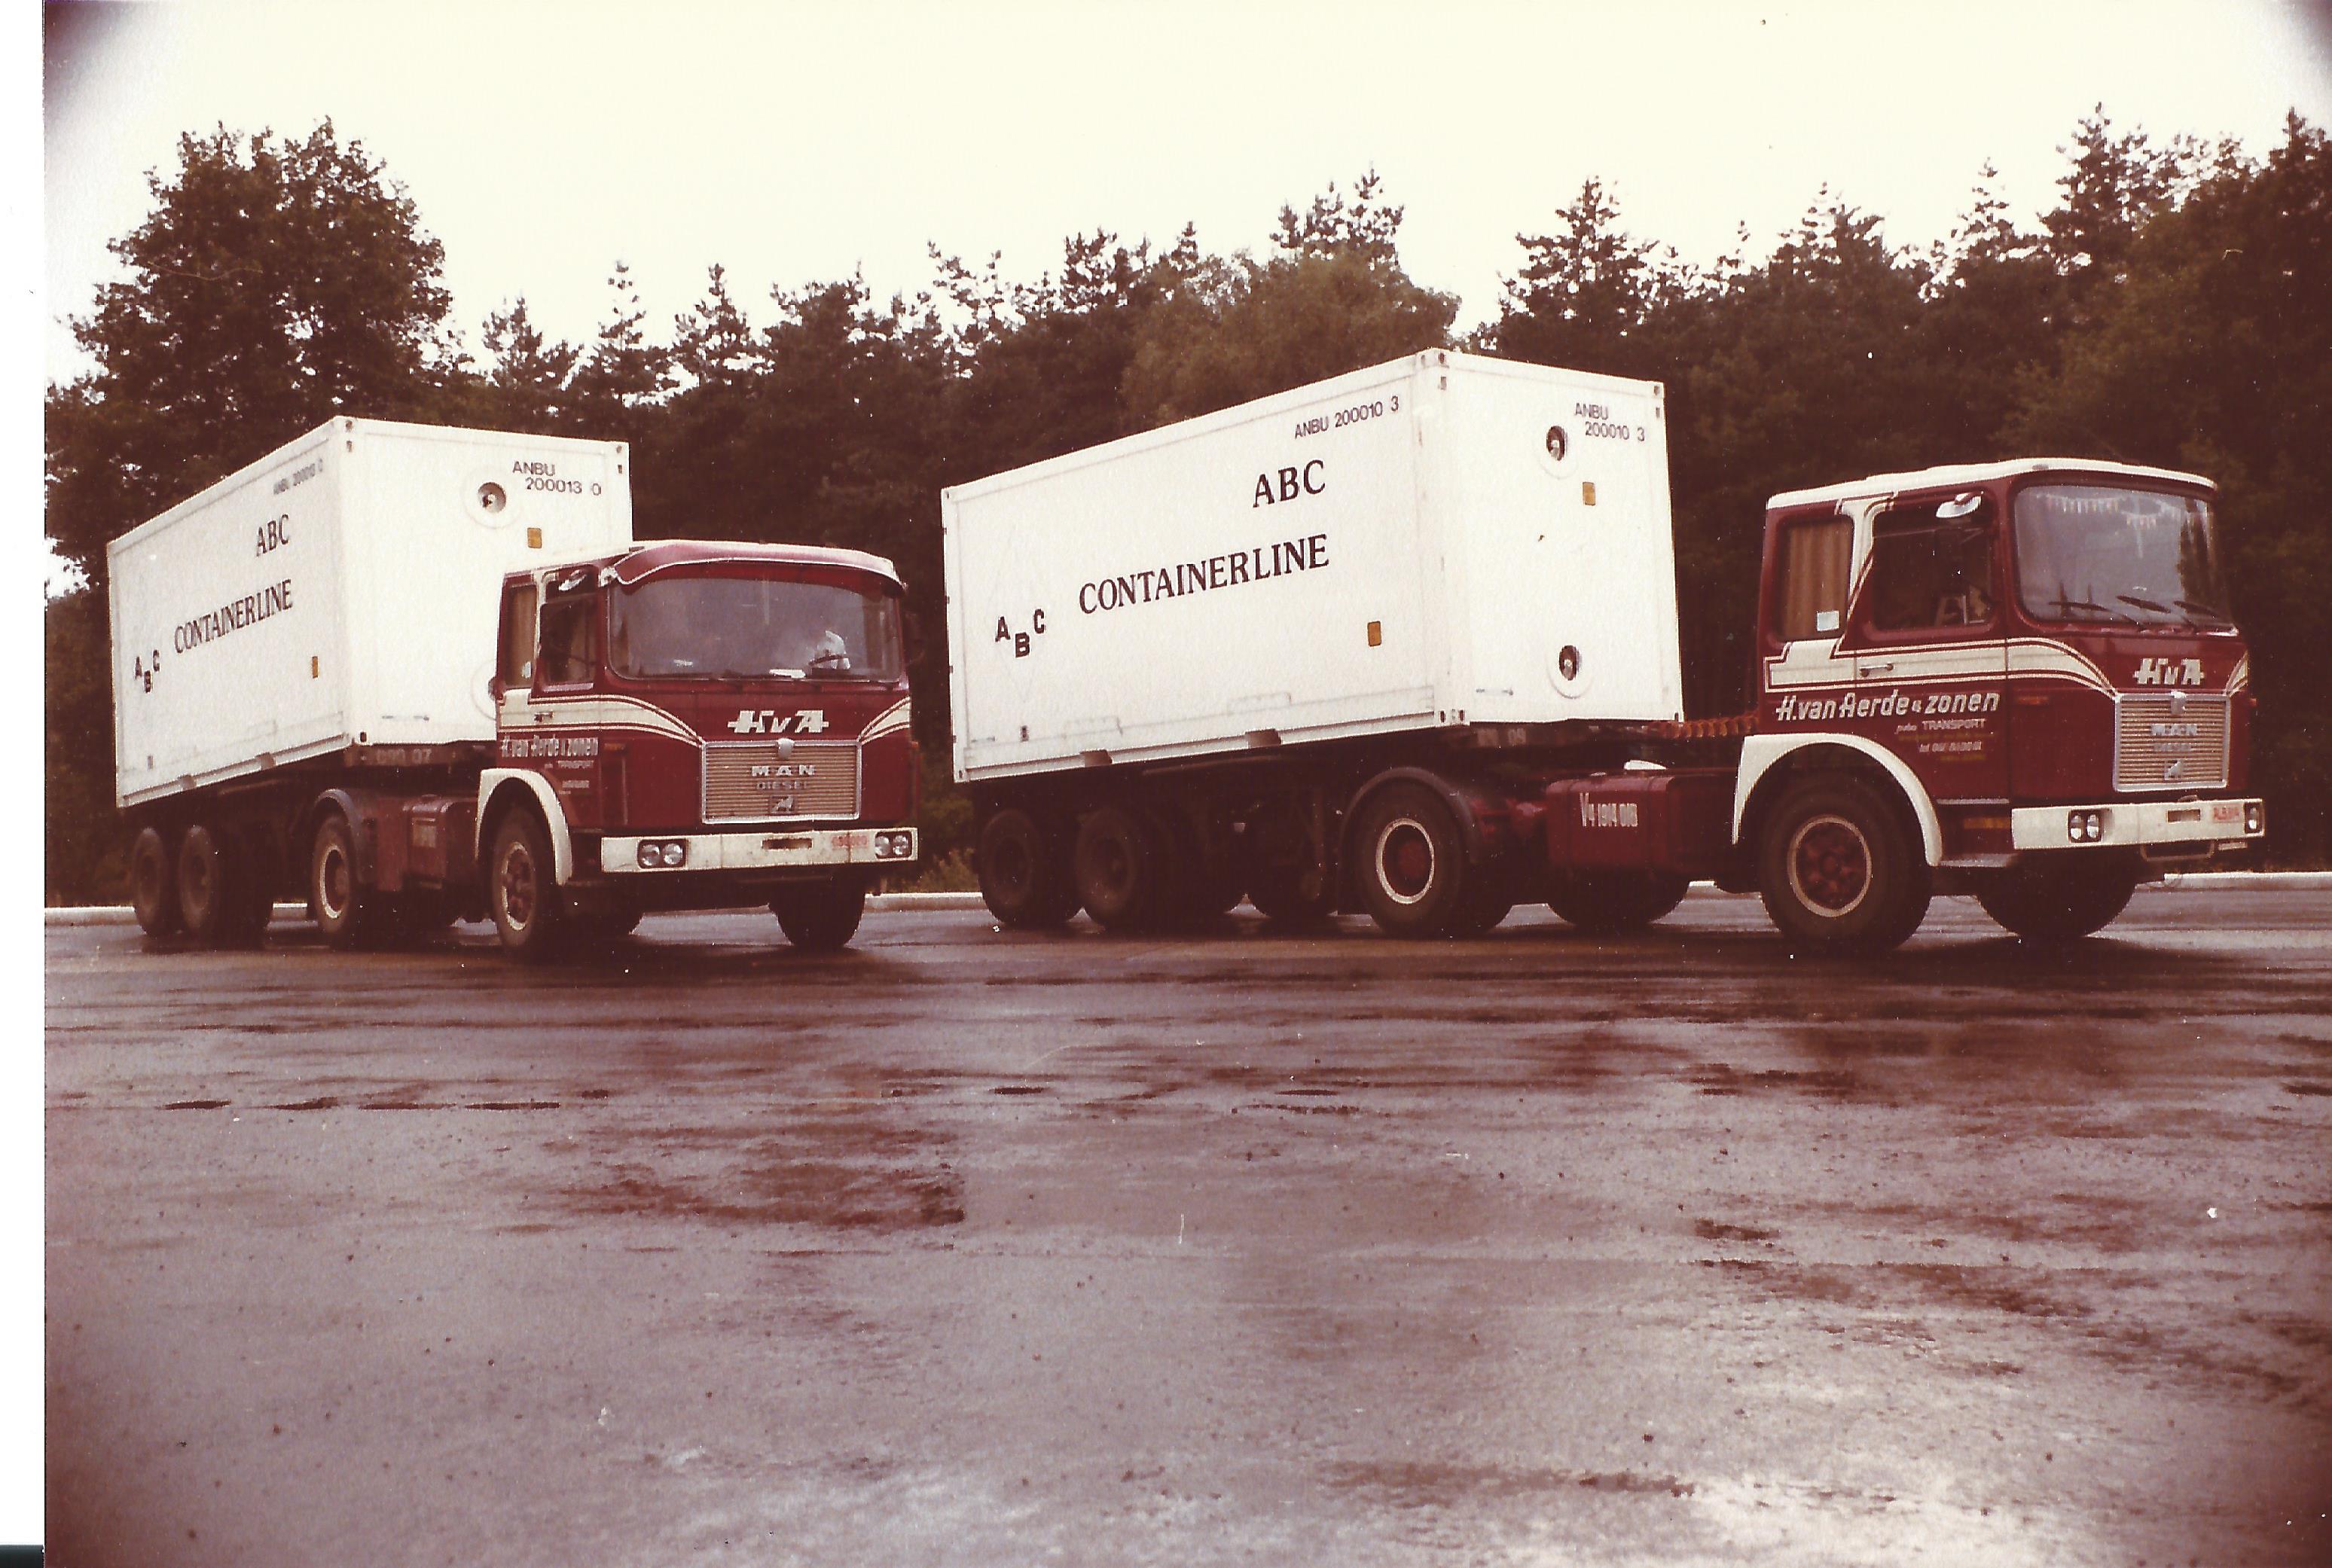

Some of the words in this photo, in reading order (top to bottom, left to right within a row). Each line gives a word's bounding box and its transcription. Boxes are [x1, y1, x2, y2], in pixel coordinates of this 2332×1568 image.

[1295, 416, 1329, 439] ANBU
[1335, 401, 1384, 428] 200010
[1390, 395, 1399, 412] 3
[1574, 402, 1609, 420] ANBU
[1585, 421, 1630, 440] 200010
[1637, 426, 1645, 441] 3
[512, 460, 555, 476] ANBU
[525, 477, 582, 494] 200013
[591, 483, 602, 496] 0
[1252, 459, 1326, 508] ABC
[256, 513, 290, 558] ABC
[1079, 533, 1329, 615] CONTAINERLINE
[174, 578, 293, 654] CONTAINERLINE
[1925, 692, 2001, 714] zonen
[752, 764, 815, 776] MAN
